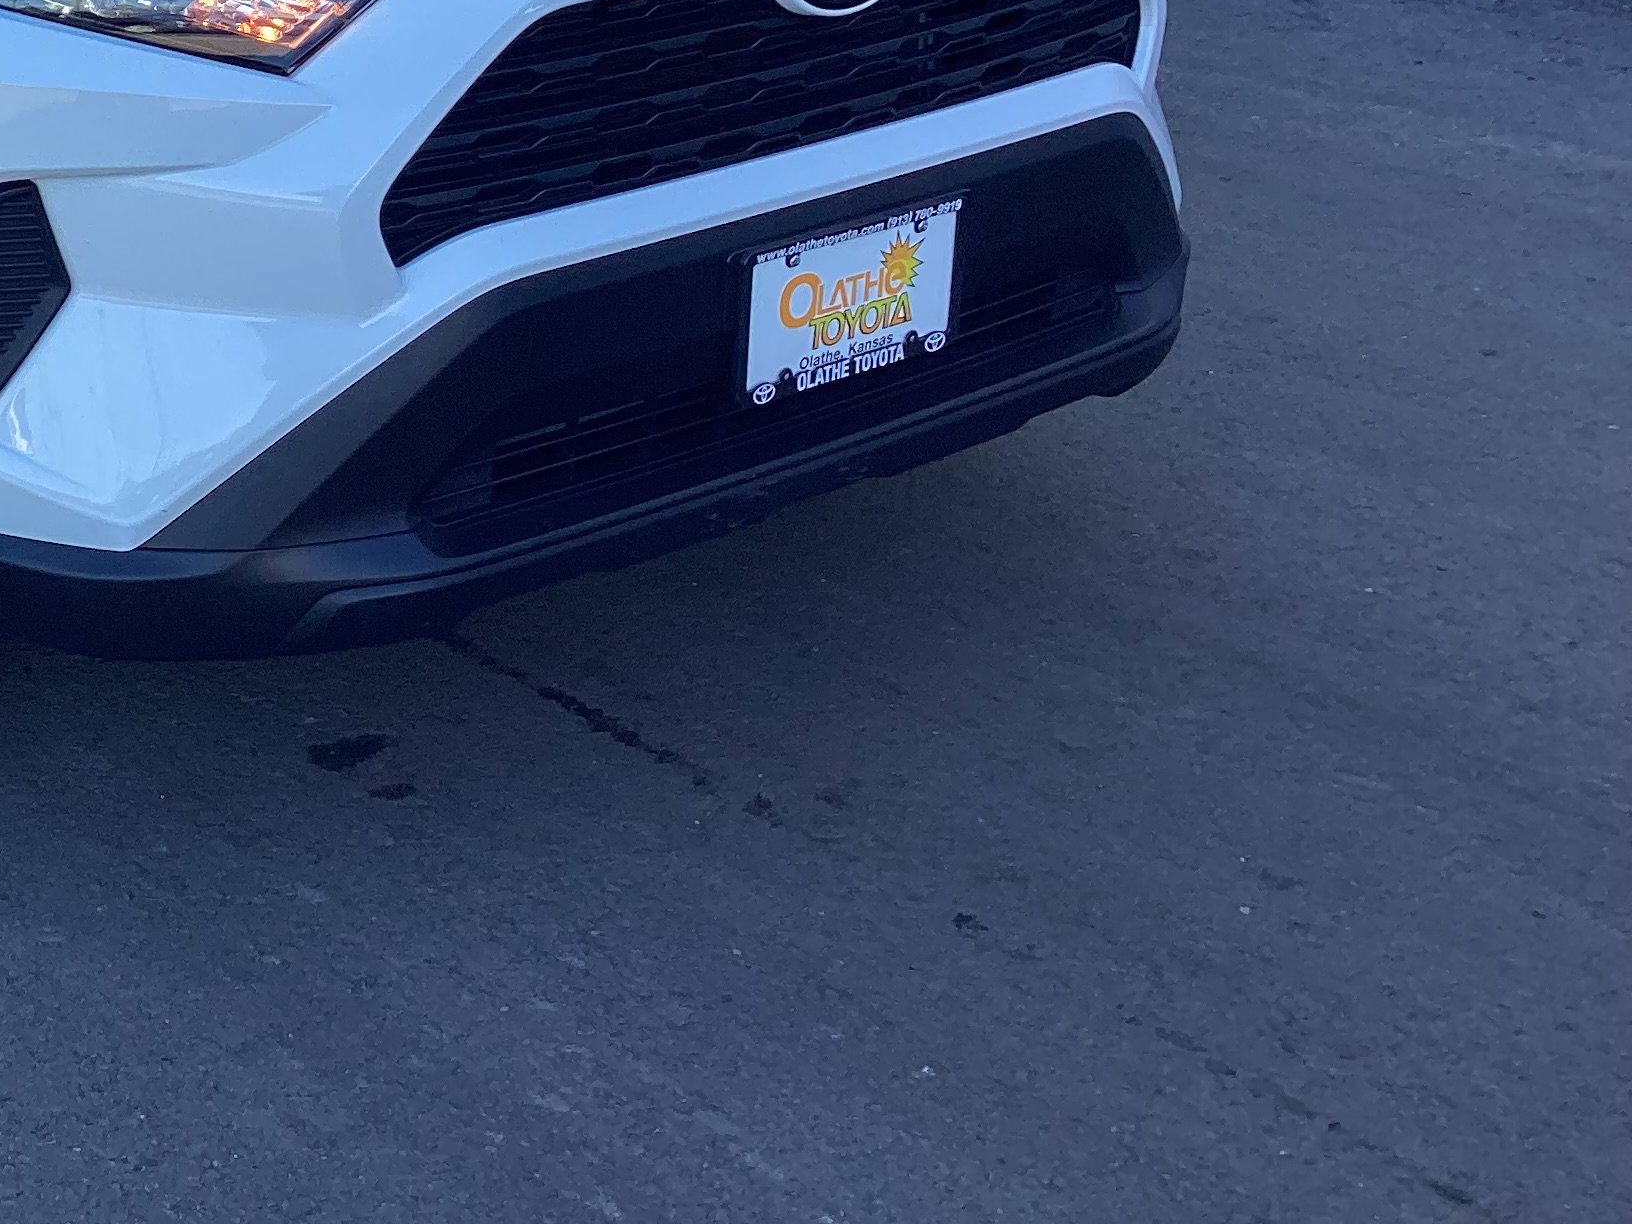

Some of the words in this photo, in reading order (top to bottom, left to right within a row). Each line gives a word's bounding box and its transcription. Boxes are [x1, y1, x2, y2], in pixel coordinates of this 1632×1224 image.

[756, 221, 885, 264] www.olathetoyota.com
[887, 215, 913, 232] (913)
[809, 291, 912, 350] TOYOTA
[848, 333, 894, 355] Kansas
[796, 361, 850, 392] OLATHE
[854, 343, 906, 374] TOYOTA
